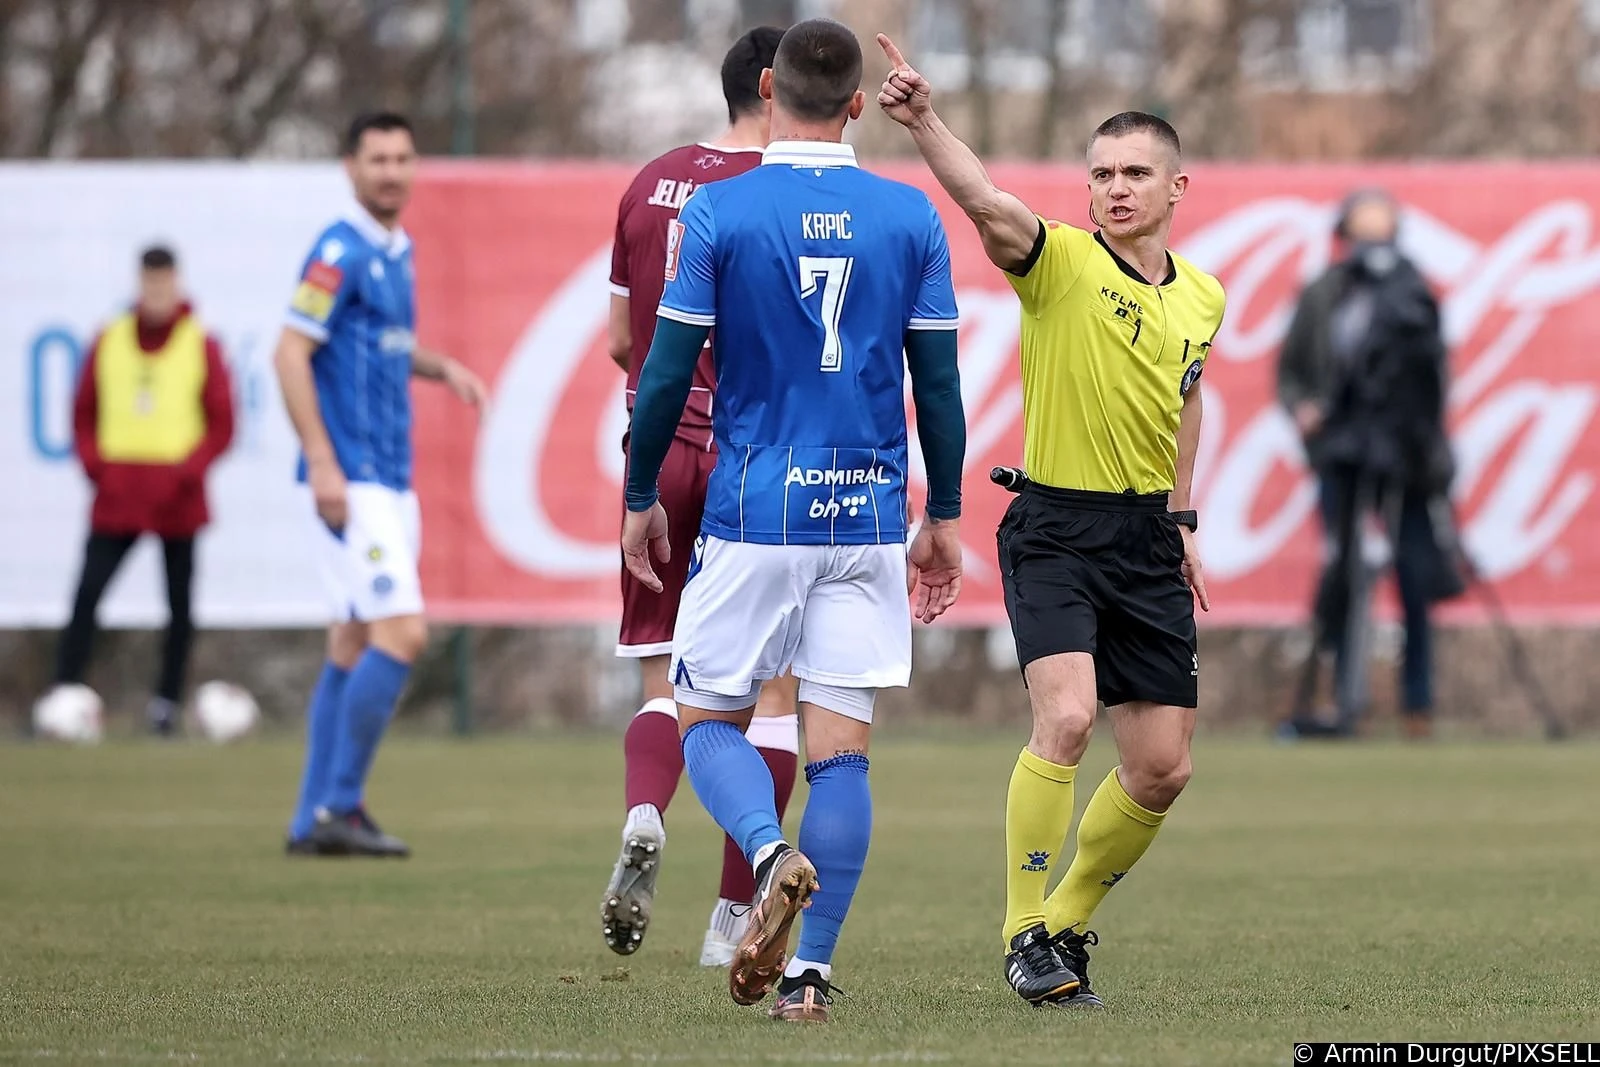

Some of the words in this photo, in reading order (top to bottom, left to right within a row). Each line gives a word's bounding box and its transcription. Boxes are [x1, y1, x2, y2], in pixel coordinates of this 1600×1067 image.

[802, 211, 853, 240] KRPIĆ
[798, 256, 855, 373] 7
[1101, 286, 1144, 315] KELME
[784, 466, 891, 487] ADMIRAL
